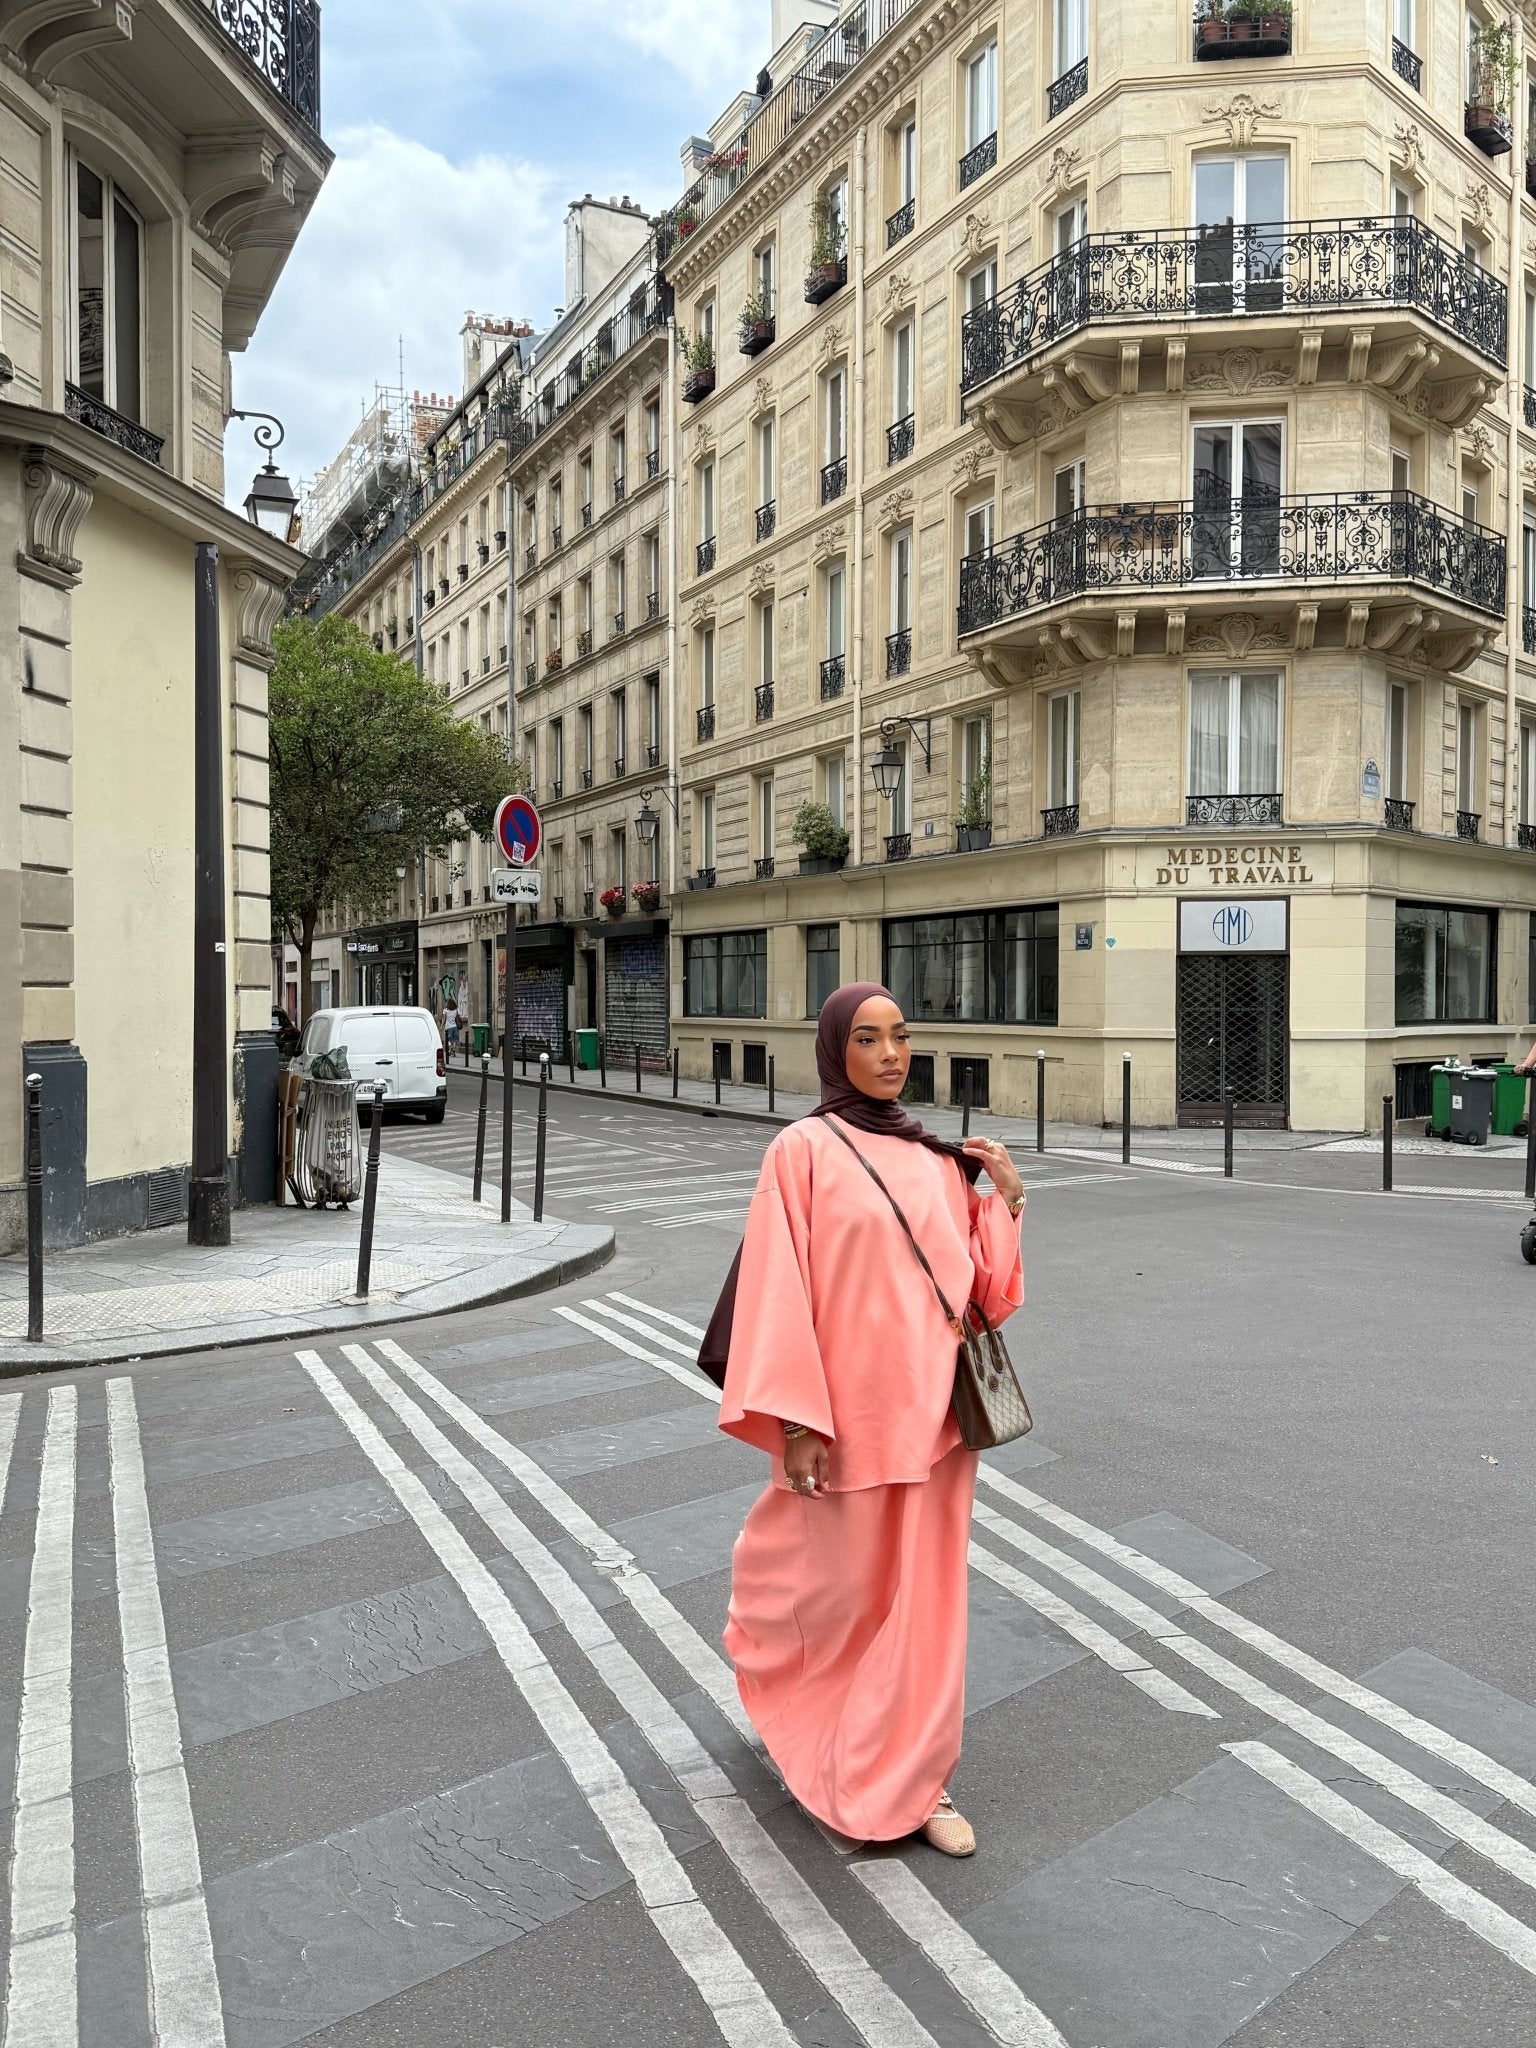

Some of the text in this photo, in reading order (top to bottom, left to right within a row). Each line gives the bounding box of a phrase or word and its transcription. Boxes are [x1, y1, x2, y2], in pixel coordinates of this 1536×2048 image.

[1167, 846, 1302, 865] MEDECINE
[1156, 866, 1313, 884] DU TRAVAIL
[1213, 906, 1250, 945] AMI
